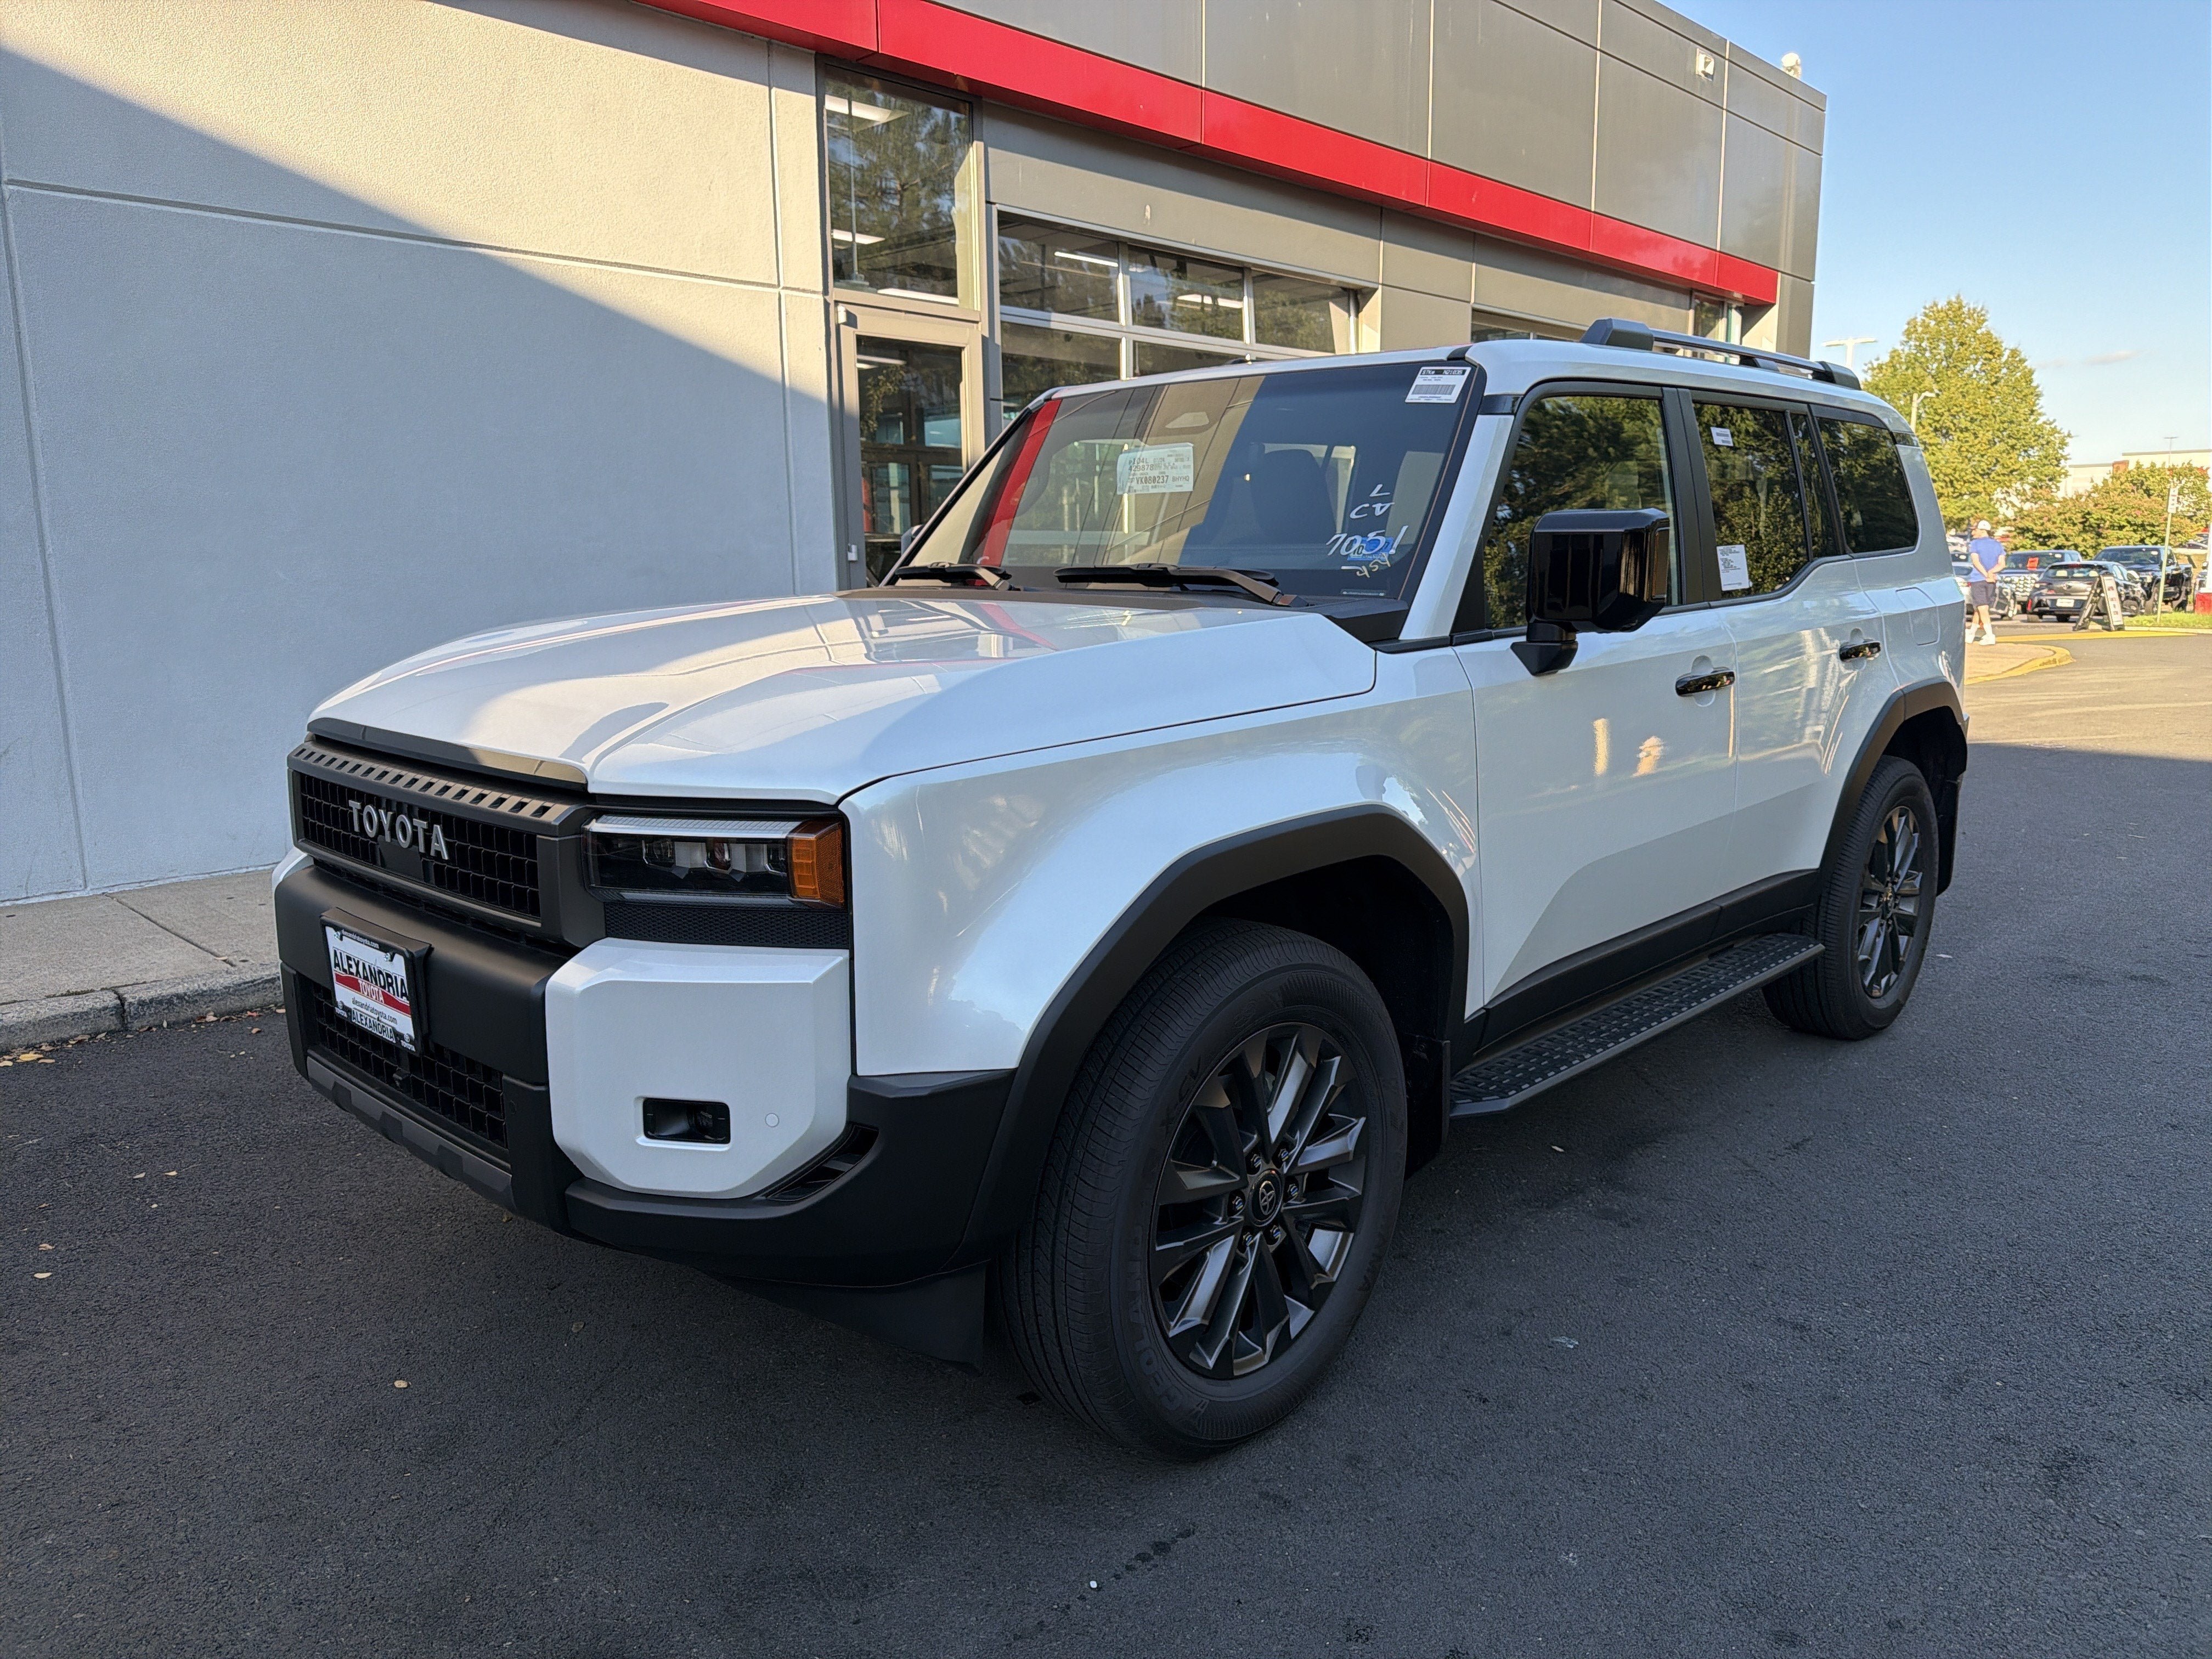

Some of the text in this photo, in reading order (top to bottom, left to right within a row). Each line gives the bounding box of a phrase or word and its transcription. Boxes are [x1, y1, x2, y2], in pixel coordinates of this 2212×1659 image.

[348, 799, 449, 860] TOYOTA
[333, 949, 409, 999] ALEXANDRIA
[358, 980, 384, 1003] TOYOTA
[351, 1009, 396, 1043] ALEXANDRIA
[352, 996, 398, 1025] alexandriatoyota.com
